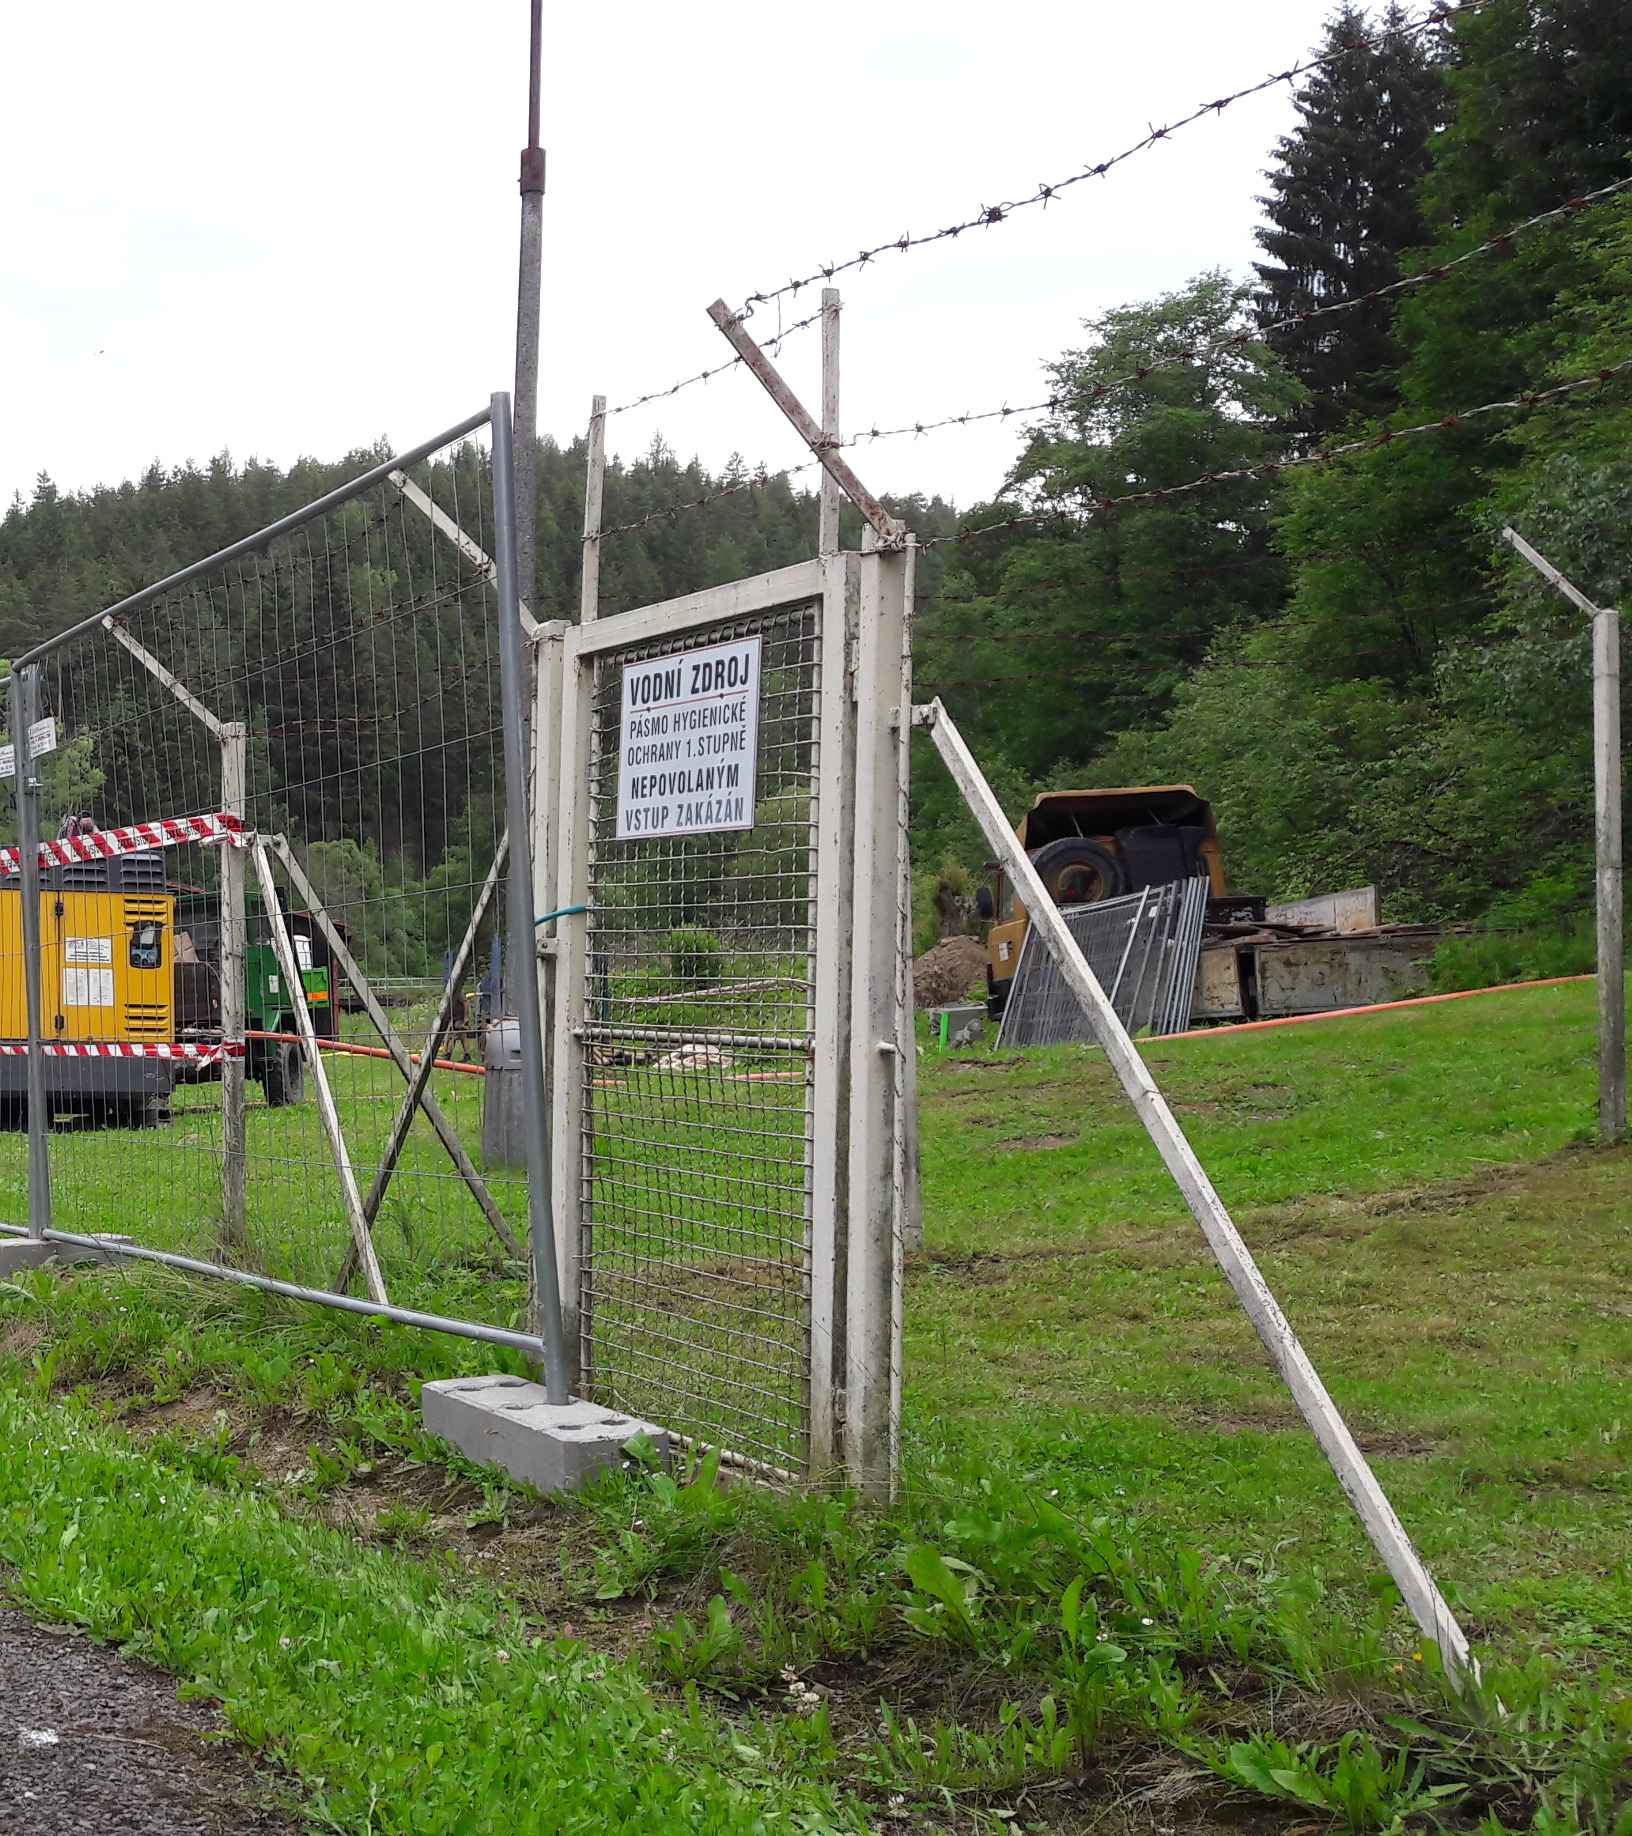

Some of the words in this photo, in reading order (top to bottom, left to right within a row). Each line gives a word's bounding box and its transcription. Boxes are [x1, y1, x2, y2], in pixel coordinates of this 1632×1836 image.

[630, 658, 684, 706] VODNÍ
[691, 653, 750, 695] ZDROJ
[630, 714, 668, 739] PÁSMO
[673, 695, 746, 733] HYGIENICKÉ
[627, 739, 682, 767] OCHRANY
[631, 757, 740, 799] NEPOVOLANÝM
[625, 805, 669, 832] VSTUP
[676, 791, 744, 827] ZAKÁZÁN
